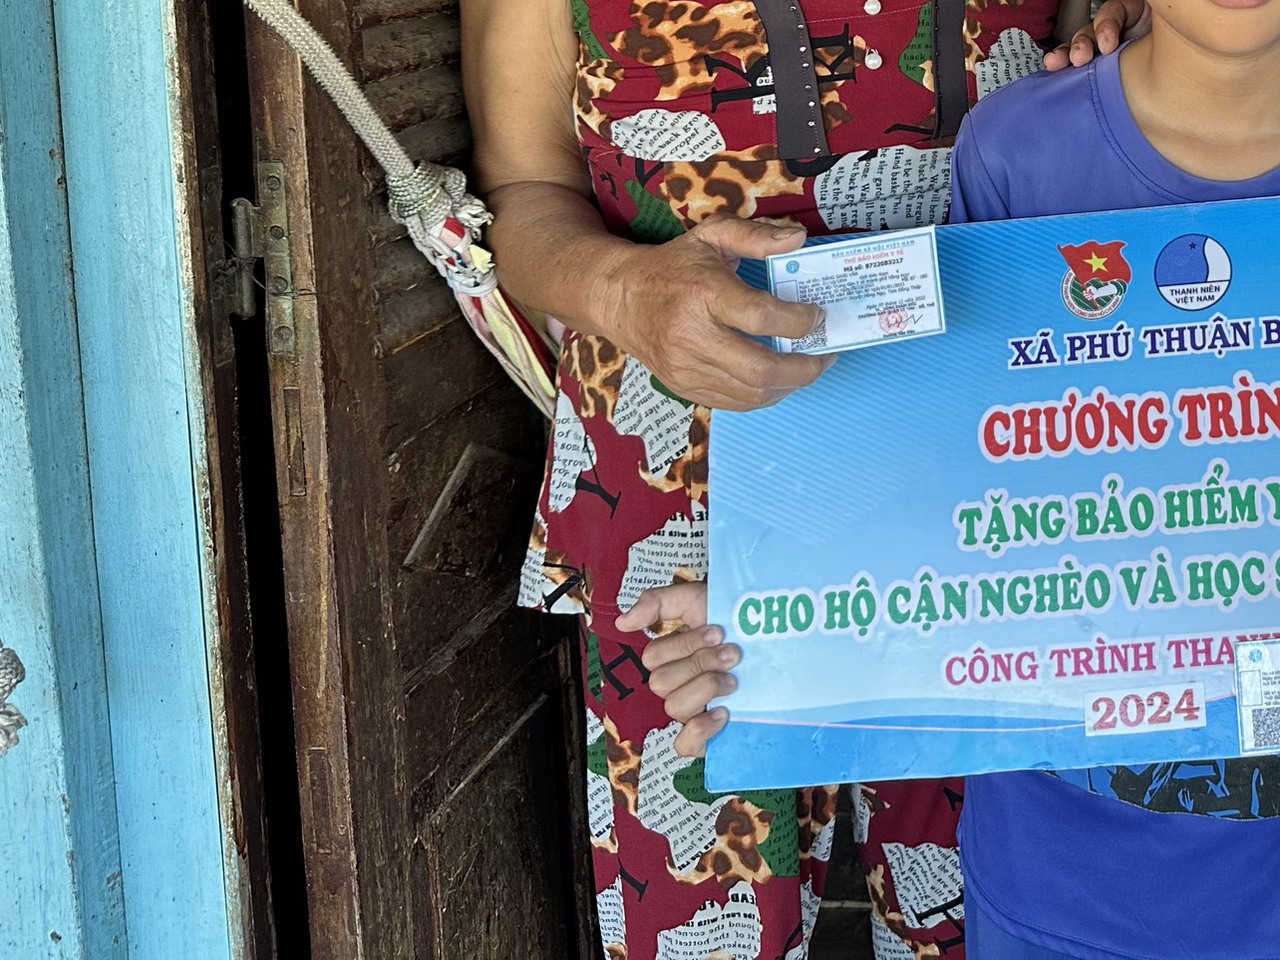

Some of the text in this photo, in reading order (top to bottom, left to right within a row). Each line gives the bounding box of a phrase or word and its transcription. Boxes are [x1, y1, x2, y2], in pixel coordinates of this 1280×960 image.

[892, 148, 904, 170] Hand
[1169, 284, 1221, 296] THANH NIÊN
[1175, 294, 1215, 305] VIỆT NAM
[1011, 333, 1057, 366] XÃ
[1067, 326, 1131, 362] PHÚ
[1143, 317, 1251, 356] THUẬN
[983, 392, 1169, 457] CHƯƠNG
[958, 495, 1065, 553] TẶNG
[1075, 479, 1155, 537] BẢO
[1164, 463, 1259, 529] HIỂM
[738, 593, 815, 636] CHO
[824, 577, 876, 636] HỘ
[887, 571, 969, 632] CẬN
[978, 560, 1111, 618] NGHÈO
[1120, 553, 1176, 606] VÀ
[1187, 558, 1265, 606] HỌC
[945, 647, 1039, 686] CÔNG
[1050, 638, 1156, 677] TRÌNH
[1092, 689, 1200, 730] 2024
